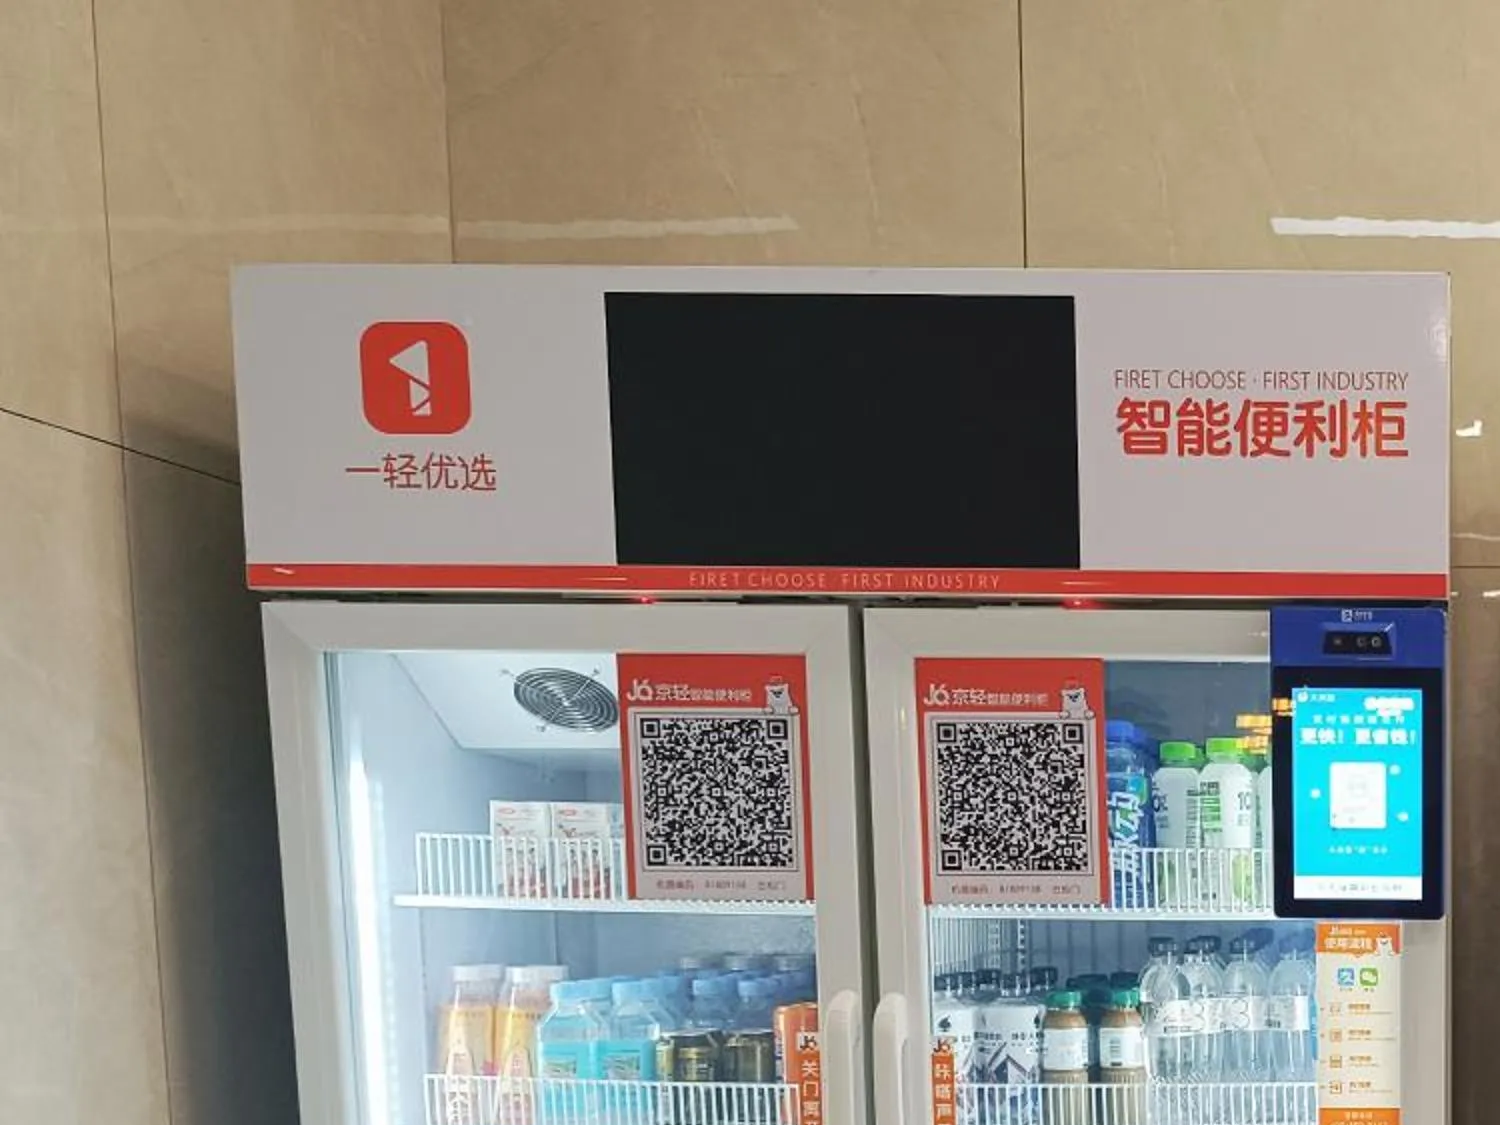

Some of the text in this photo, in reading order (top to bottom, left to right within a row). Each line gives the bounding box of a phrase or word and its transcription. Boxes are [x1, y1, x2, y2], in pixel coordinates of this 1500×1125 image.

[1114, 369, 1409, 392] FIRET CHOOSE FIRST INDUSTRY
[1116, 397, 1409, 459] 智能便利柜
[345, 451, 497, 491] 一轻优选
[749, 572, 827, 588] CHOOSE
[841, 573, 894, 589] FIRST
[904, 573, 1001, 590] INDUSTRY
